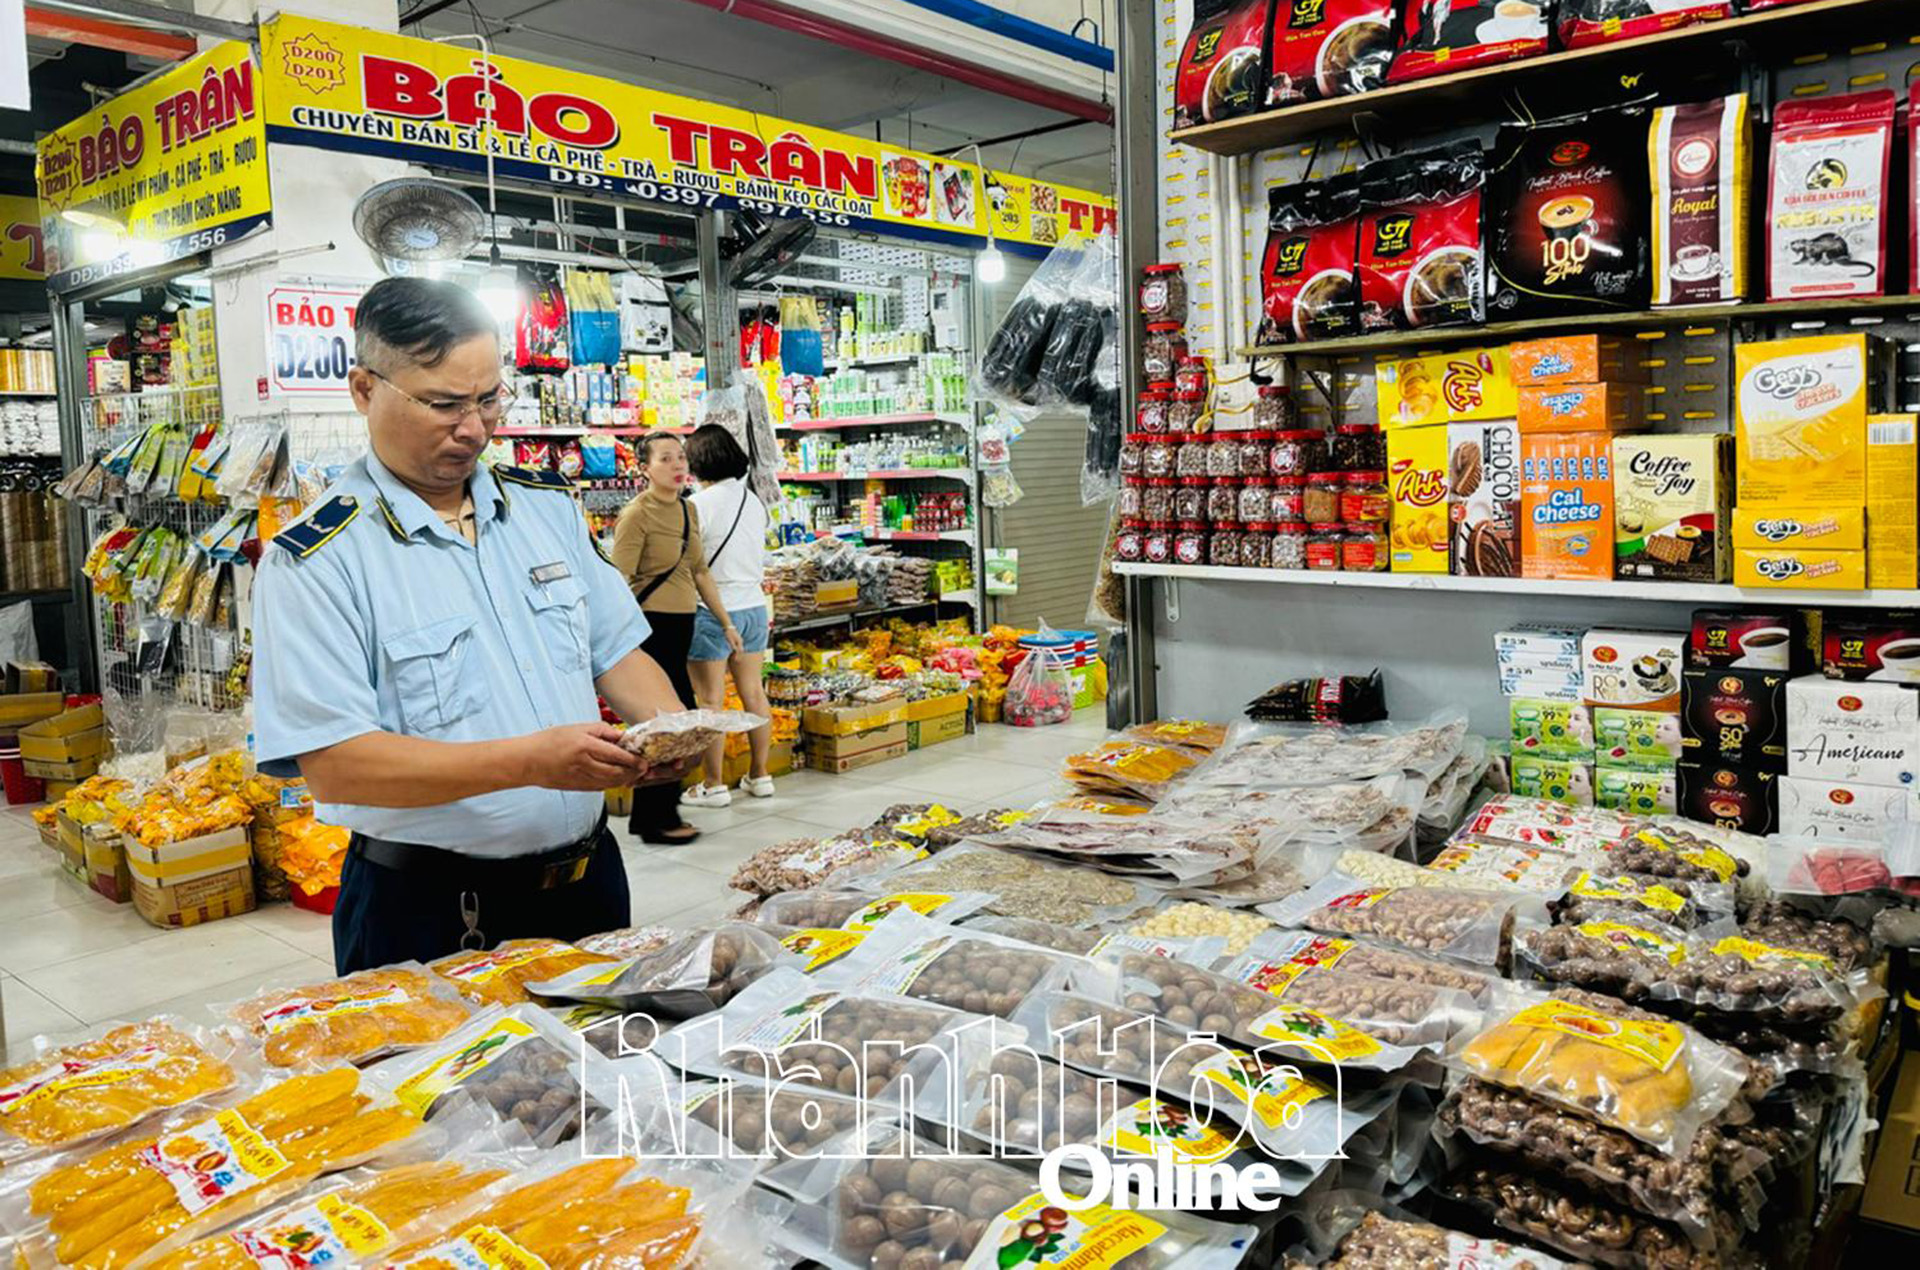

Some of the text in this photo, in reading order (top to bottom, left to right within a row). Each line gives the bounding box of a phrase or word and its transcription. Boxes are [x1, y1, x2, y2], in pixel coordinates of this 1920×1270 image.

[291, 45, 336, 63] D200
[293, 63, 335, 81] D201
[154, 60, 255, 154] TRÂN
[361, 54, 878, 201] BẢO TRÂN
[292, 107, 394, 138] CHUYÊN
[402, 123, 451, 146] BÁN
[536, 142, 560, 163] CÀ
[567, 150, 603, 171] PHÊ
[622, 158, 656, 180] TRÀ
[736, 176, 778, 201] BÁNH
[783, 189, 810, 209] KẸO
[815, 190, 837, 210] CÁC
[842, 199, 872, 220] LOẠI
[637, 182, 719, 208] 0397
[738, 198, 792, 217] 997
[801, 208, 850, 227] 556
[1671, 195, 1718, 216] Royal
[188, 227, 226, 249] 556
[1540, 237, 1590, 268] 100
[276, 296, 335, 328] BẢO
[1754, 364, 1820, 399] Gery
[1629, 450, 1692, 477] Coffee
[1550, 488, 1582, 507] Cal
[1654, 473, 1695, 496] Joy
[1719, 727, 1743, 742] 50
[1791, 732, 1904, 766] Americano
